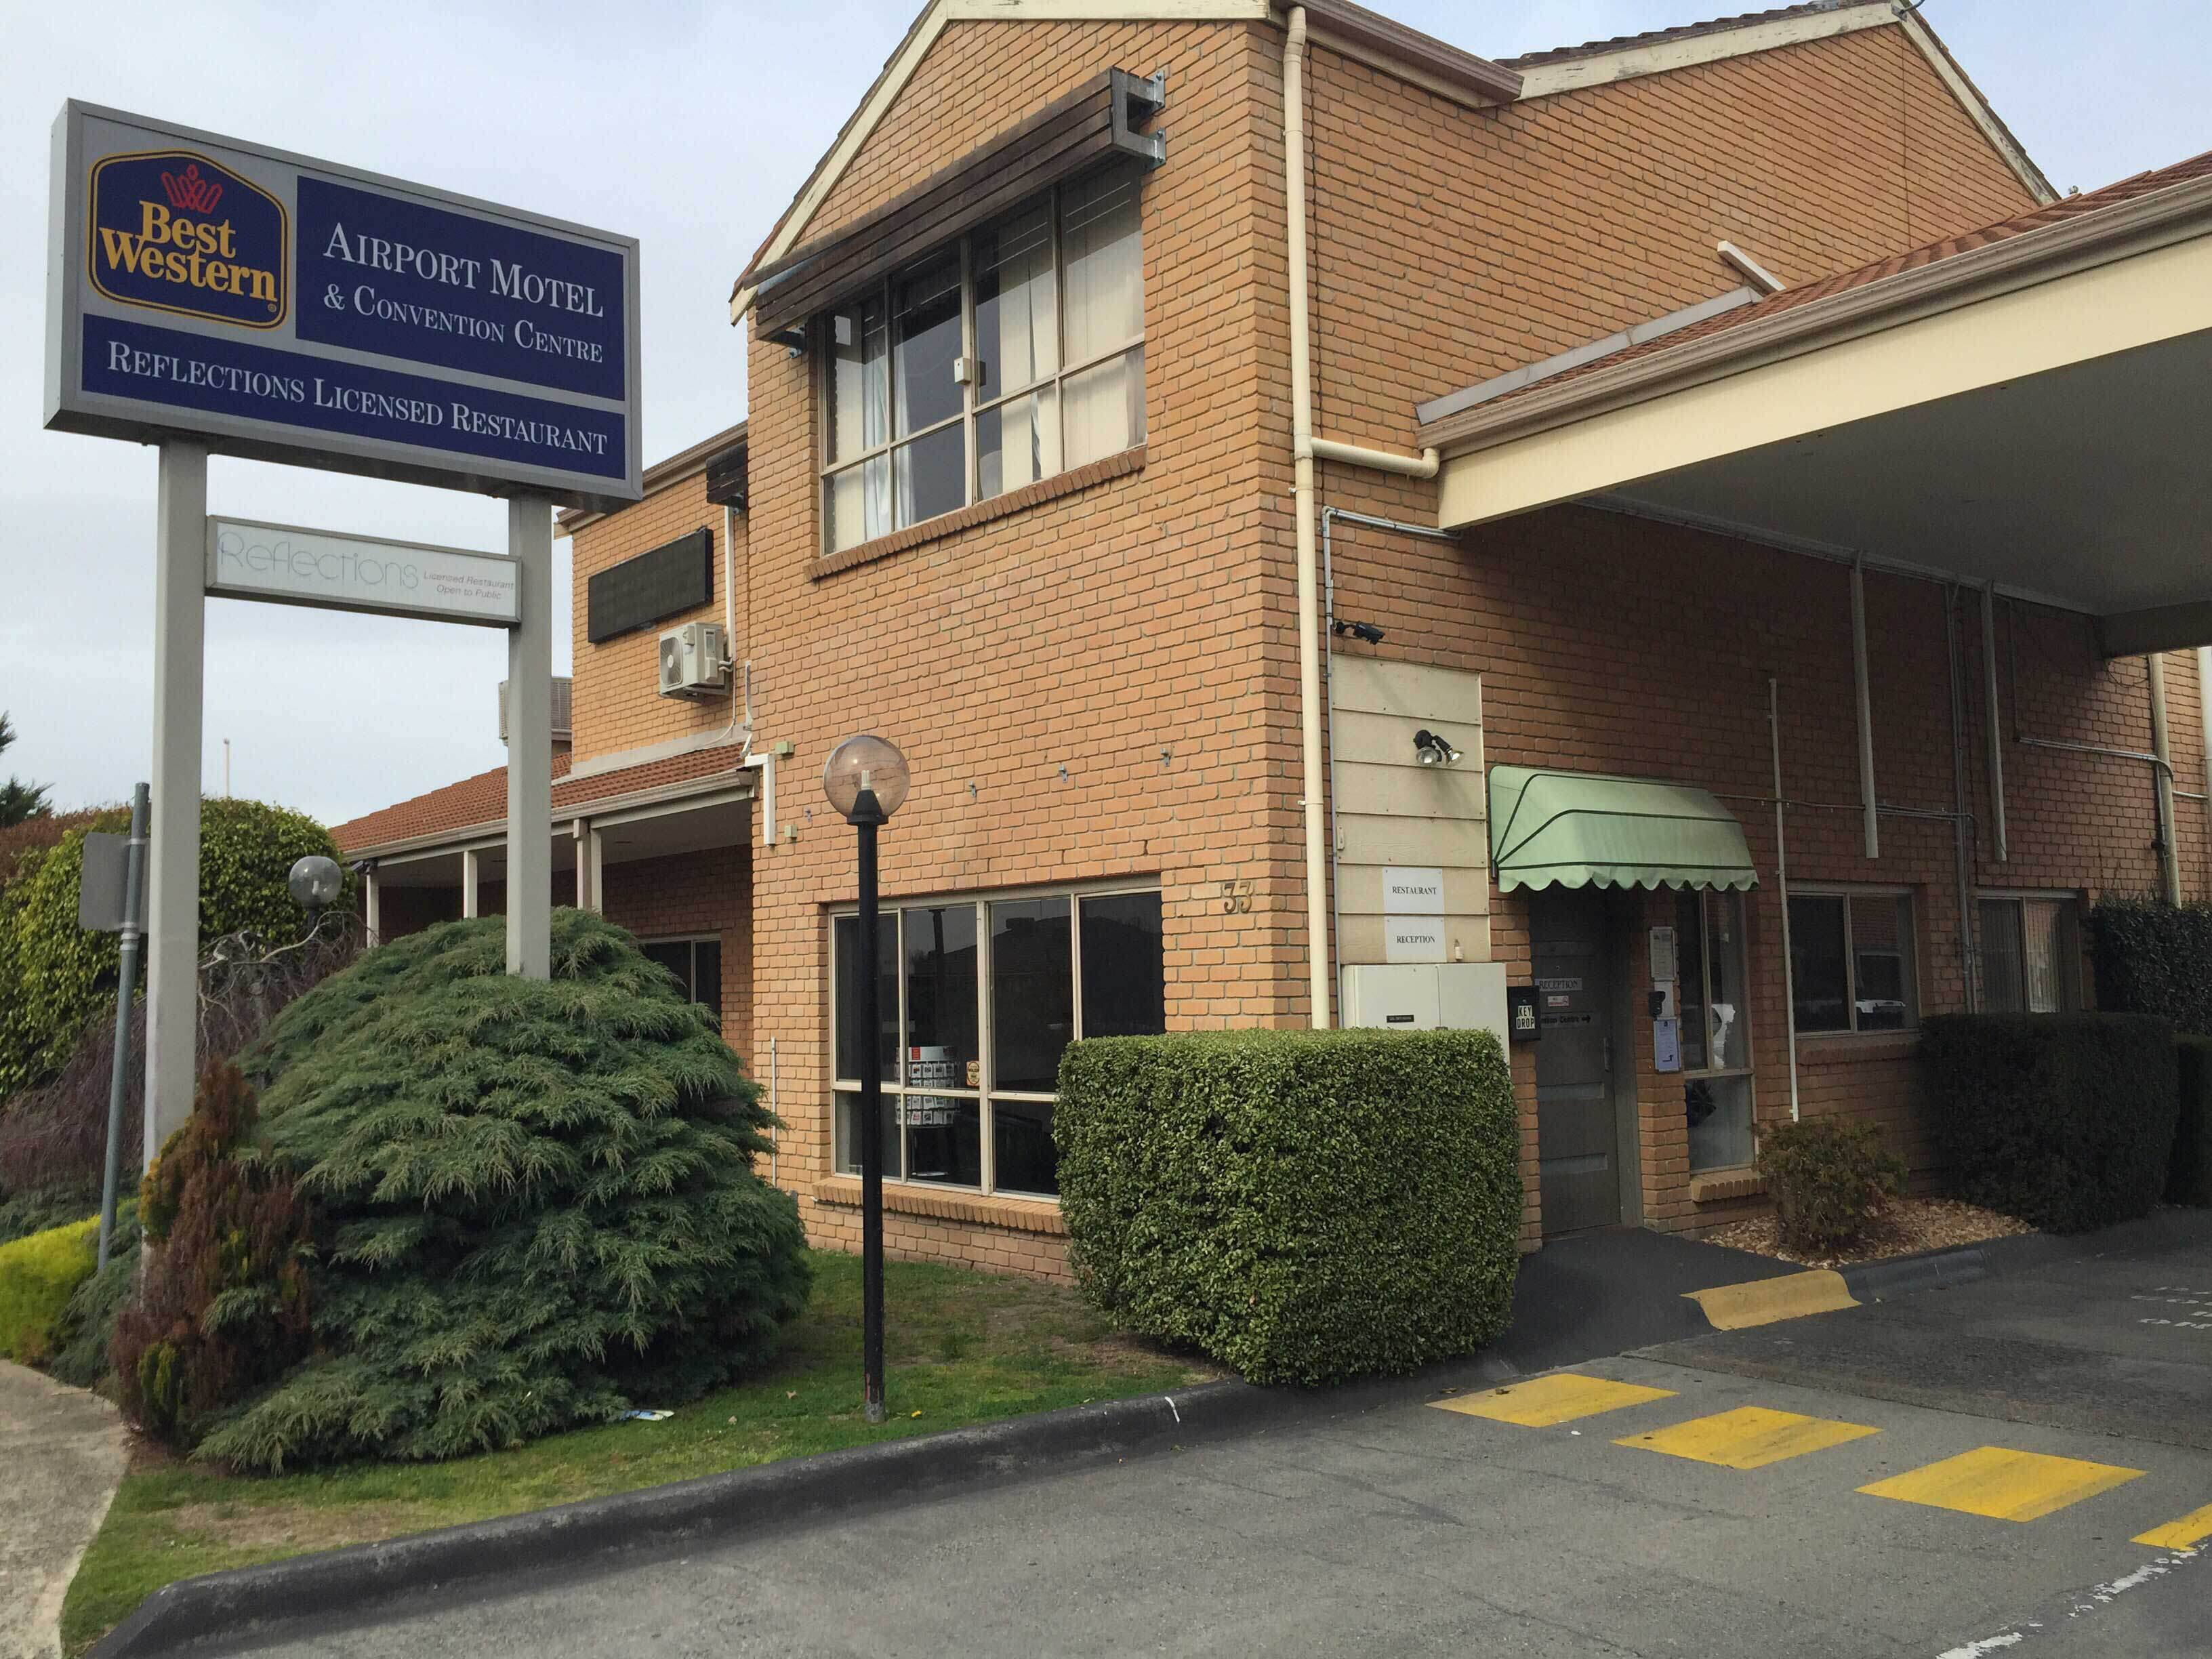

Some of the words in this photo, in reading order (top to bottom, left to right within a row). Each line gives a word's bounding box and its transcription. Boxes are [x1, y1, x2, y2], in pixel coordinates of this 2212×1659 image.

[139, 200, 236, 259] Best
[99, 226, 278, 302] Western
[323, 283, 346, 310] &
[218, 532, 418, 589] Reflections
[424, 571, 465, 584] Licensed
[466, 576, 515, 590] Restaurant
[436, 584, 461, 596] Open
[464, 588, 473, 596] to
[475, 589, 502, 600] Public
[1223, 881, 1252, 914] 33
[1391, 885, 1437, 895] RESTAURANT
[1396, 935, 1436, 944] RECEPTION
[1518, 1006, 1532, 1017] KEY
[1517, 1017, 1535, 1029] DROP
